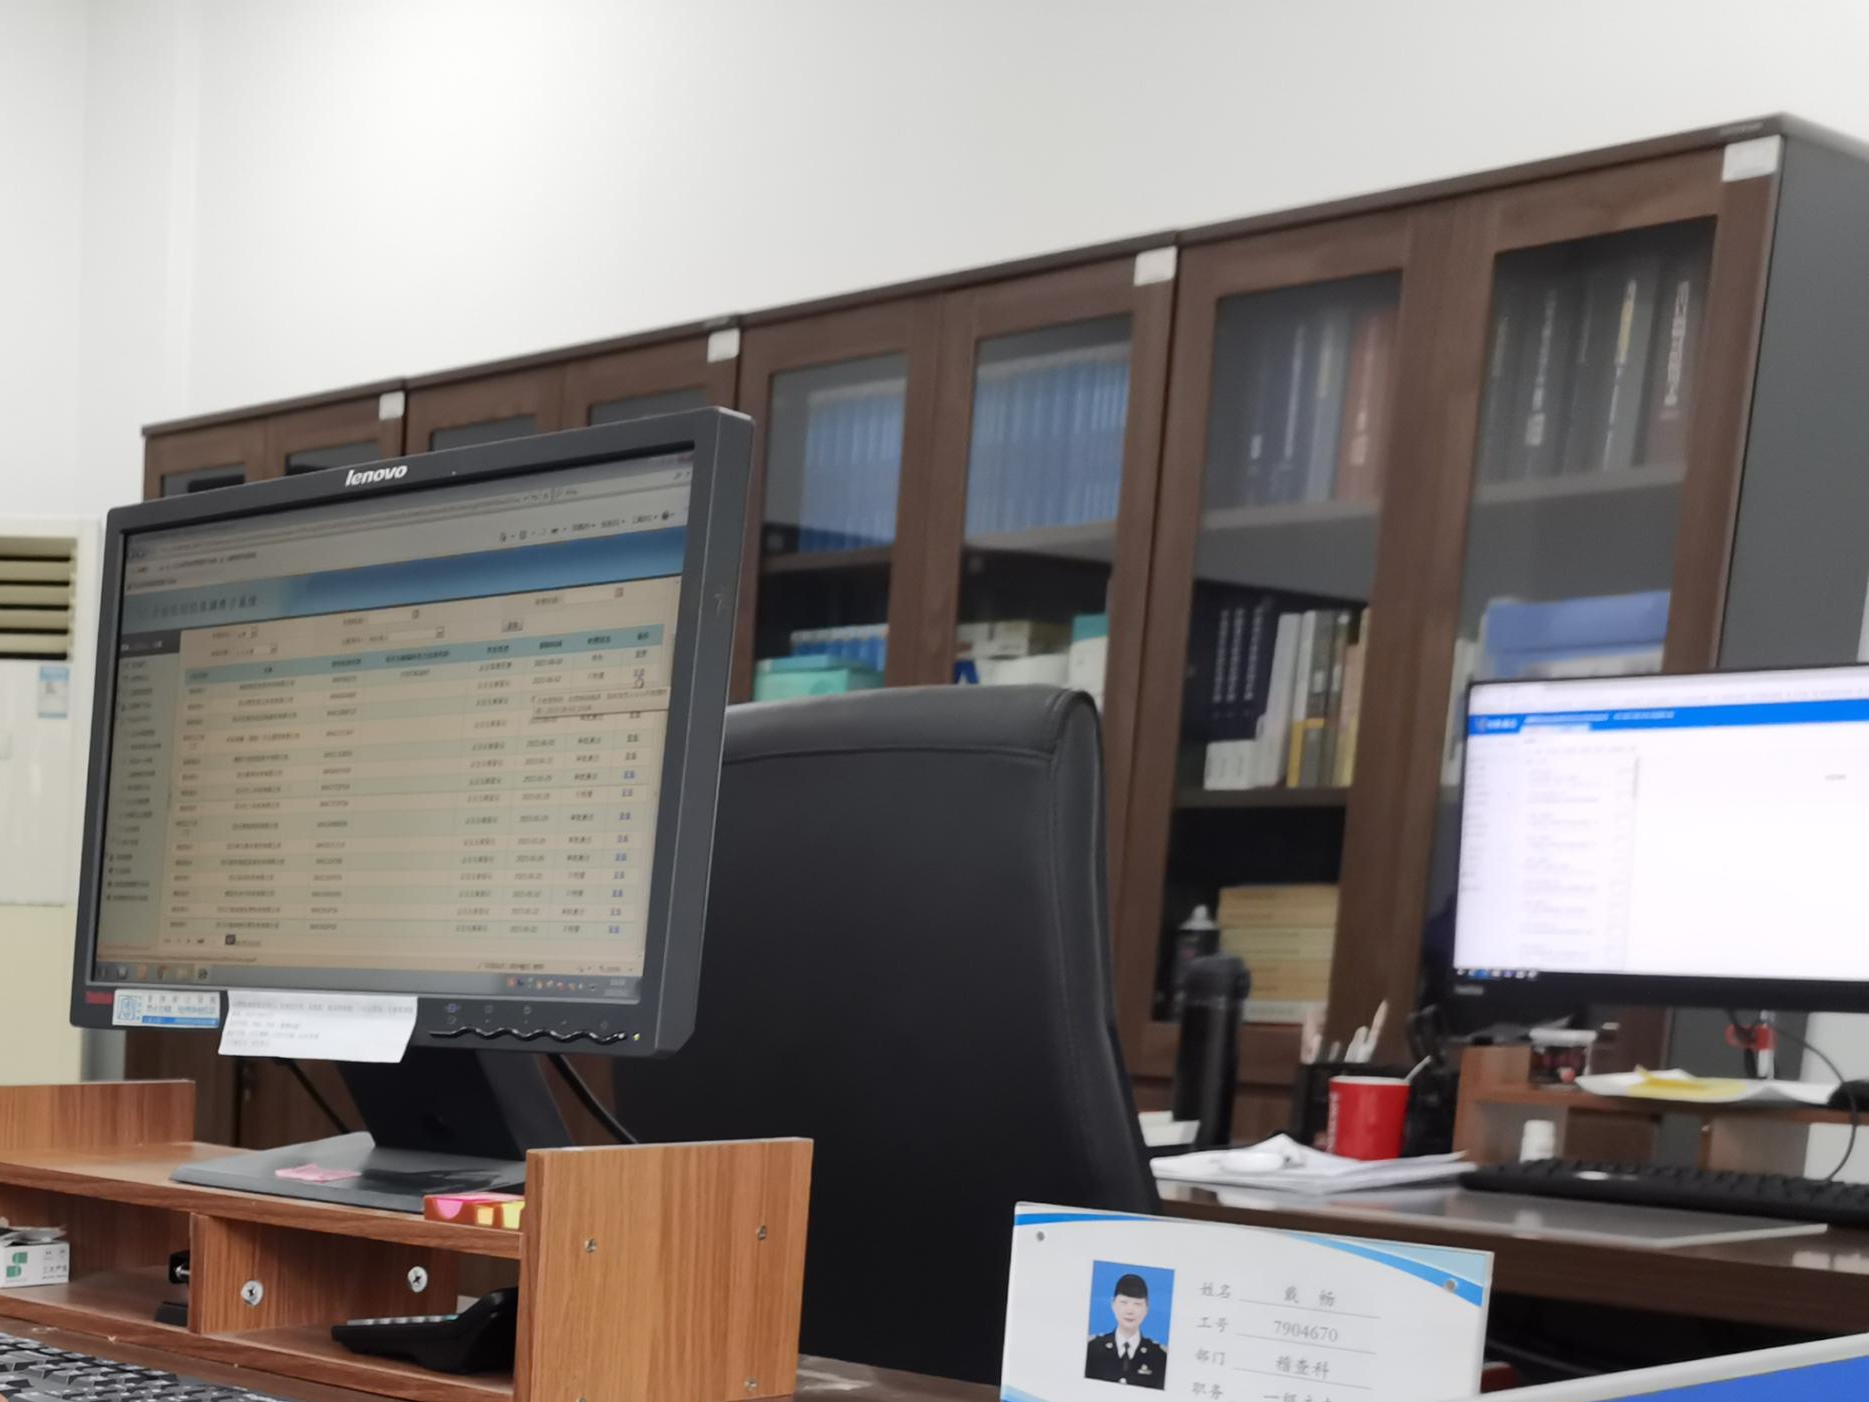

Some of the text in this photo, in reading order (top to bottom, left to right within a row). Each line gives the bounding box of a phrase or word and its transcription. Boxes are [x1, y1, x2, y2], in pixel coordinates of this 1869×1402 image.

[345, 465, 408, 487] lenovo
[1200, 1281, 1231, 1299] 姓名
[1196, 1316, 1339, 1343] 工号 7904670
[1194, 1347, 1330, 1380] 部门 稽查科
[1191, 1381, 1224, 1401] 职务
